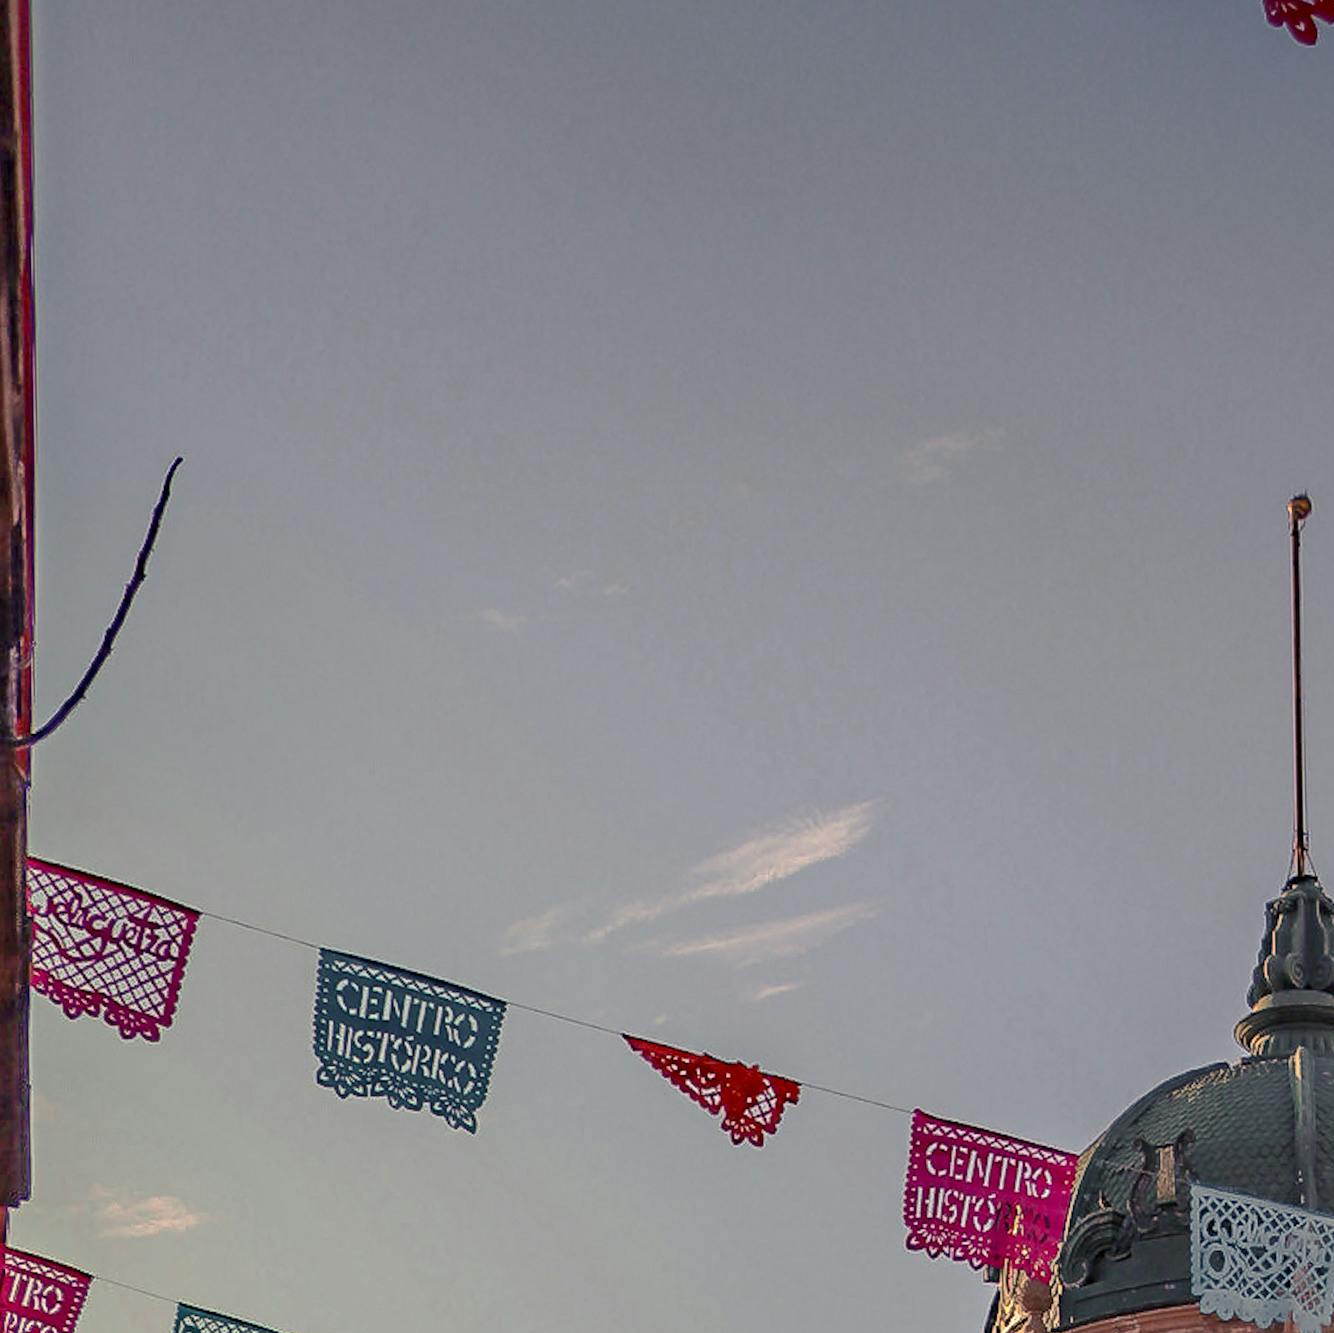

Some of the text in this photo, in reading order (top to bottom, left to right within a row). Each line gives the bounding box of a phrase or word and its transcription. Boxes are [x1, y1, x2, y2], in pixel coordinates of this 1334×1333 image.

[335, 978, 480, 1050] CENTRO
[327, 1020, 479, 1098] HISTÓRICO
[924, 1140, 1053, 1199] CENTRO
